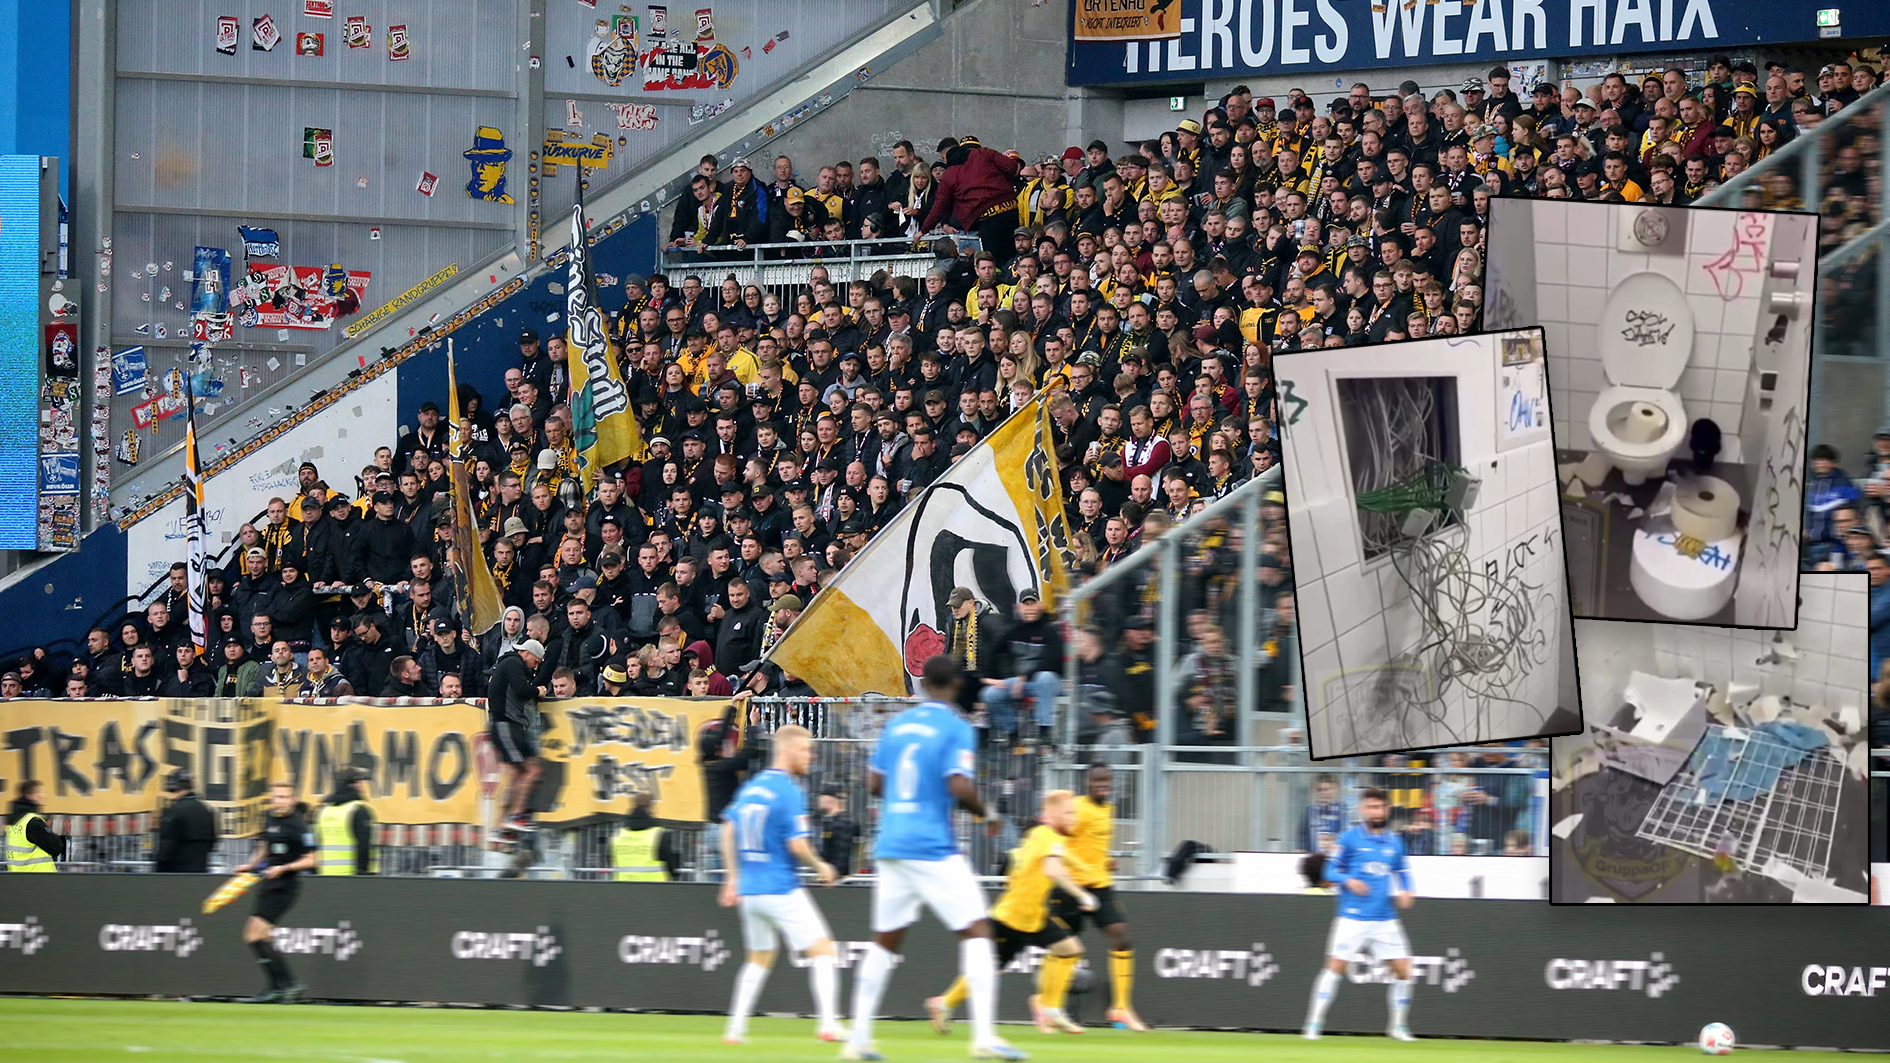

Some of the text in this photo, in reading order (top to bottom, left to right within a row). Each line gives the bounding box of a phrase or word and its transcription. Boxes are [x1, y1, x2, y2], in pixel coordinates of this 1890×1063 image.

[1371, 0, 1547, 59] WEAR
[1570, 0, 1719, 47] HAIX
[655, 53, 684, 67] IN THE
[543, 143, 604, 159] SÜDKURVE
[0, 720, 161, 797] TRAS
[278, 720, 469, 801] YNAMO
[895, 743, 921, 800] 6
[0, 922, 26, 949] FT
[99, 923, 180, 951] CRAFT
[272, 926, 341, 954] RAFT
[451, 930, 538, 960] CRAFT
[618, 934, 703, 964] CRAFT
[1153, 947, 1252, 979] CRAFT
[1347, 952, 1452, 985] CFT
[1543, 957, 1650, 990] CRAFT
[1801, 964, 1890, 997] CRAF
